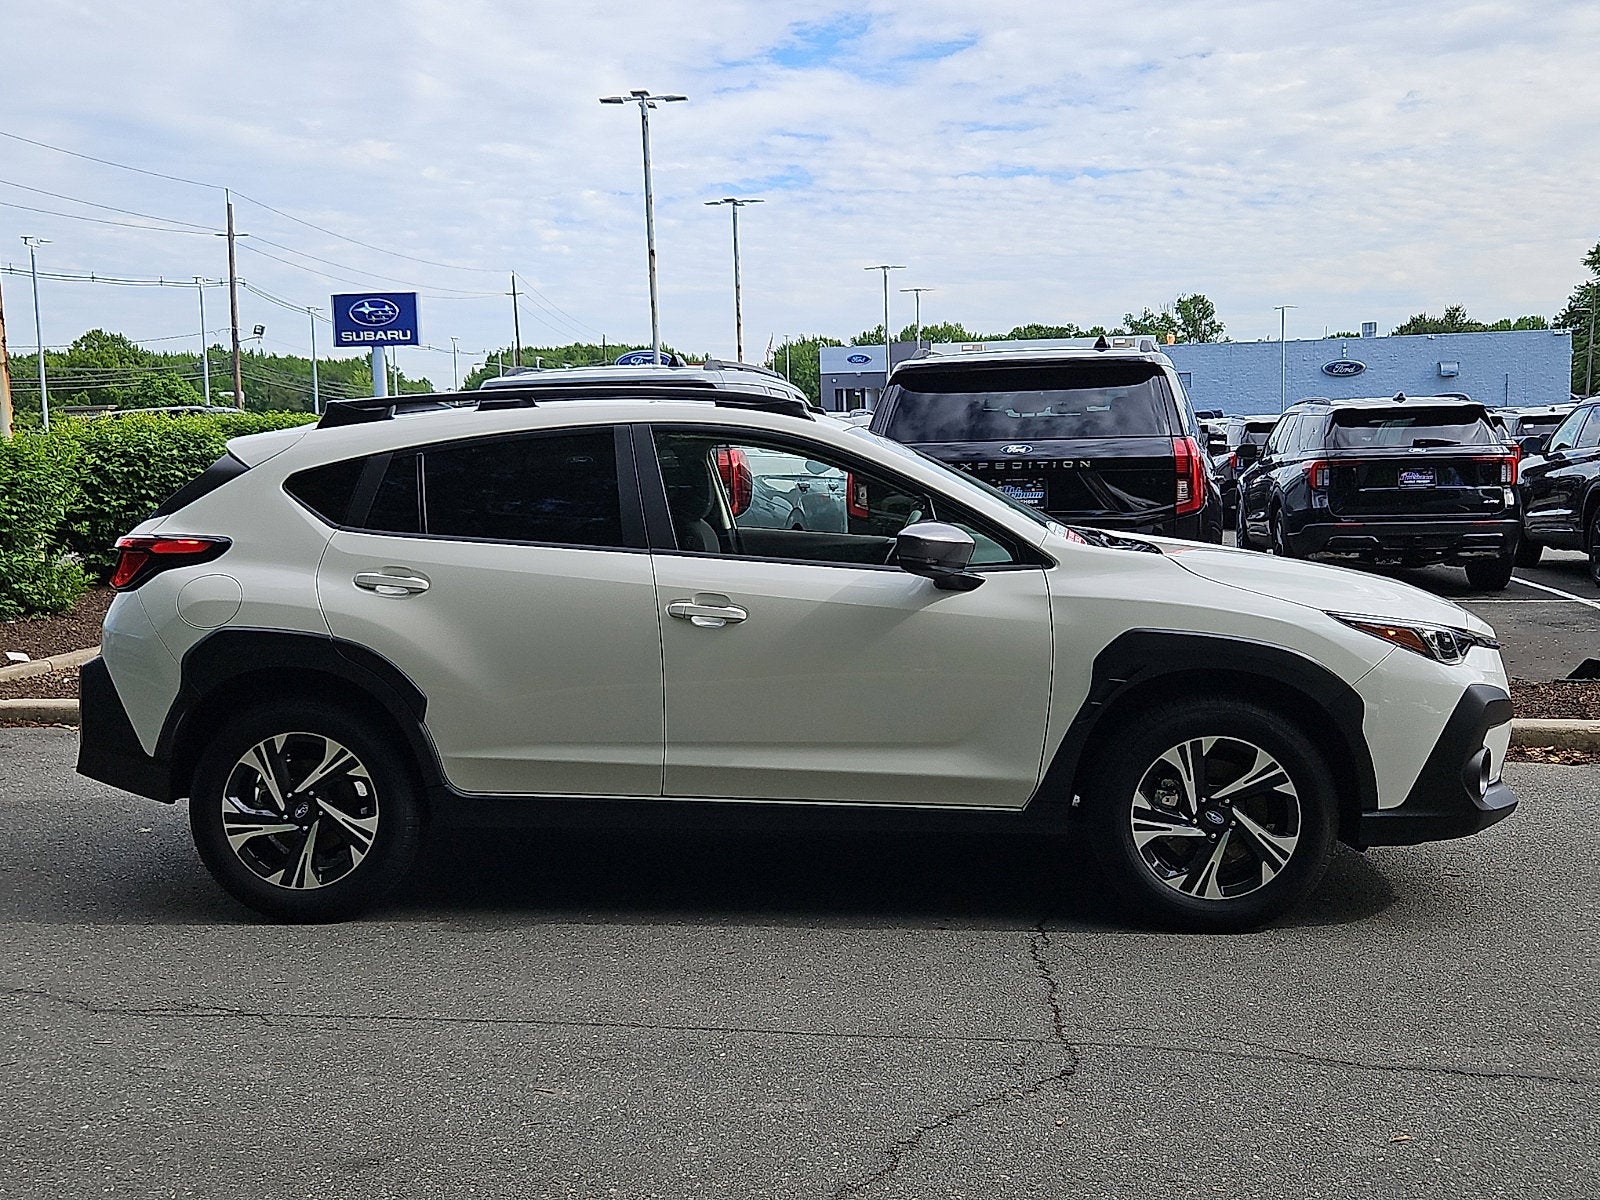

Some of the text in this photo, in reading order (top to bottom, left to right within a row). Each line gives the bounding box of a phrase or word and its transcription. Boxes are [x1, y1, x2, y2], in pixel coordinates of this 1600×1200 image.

[341, 329, 411, 342] SUBARU
[1332, 363, 1356, 373] Ford
[949, 460, 1091, 471] XPEDITION
